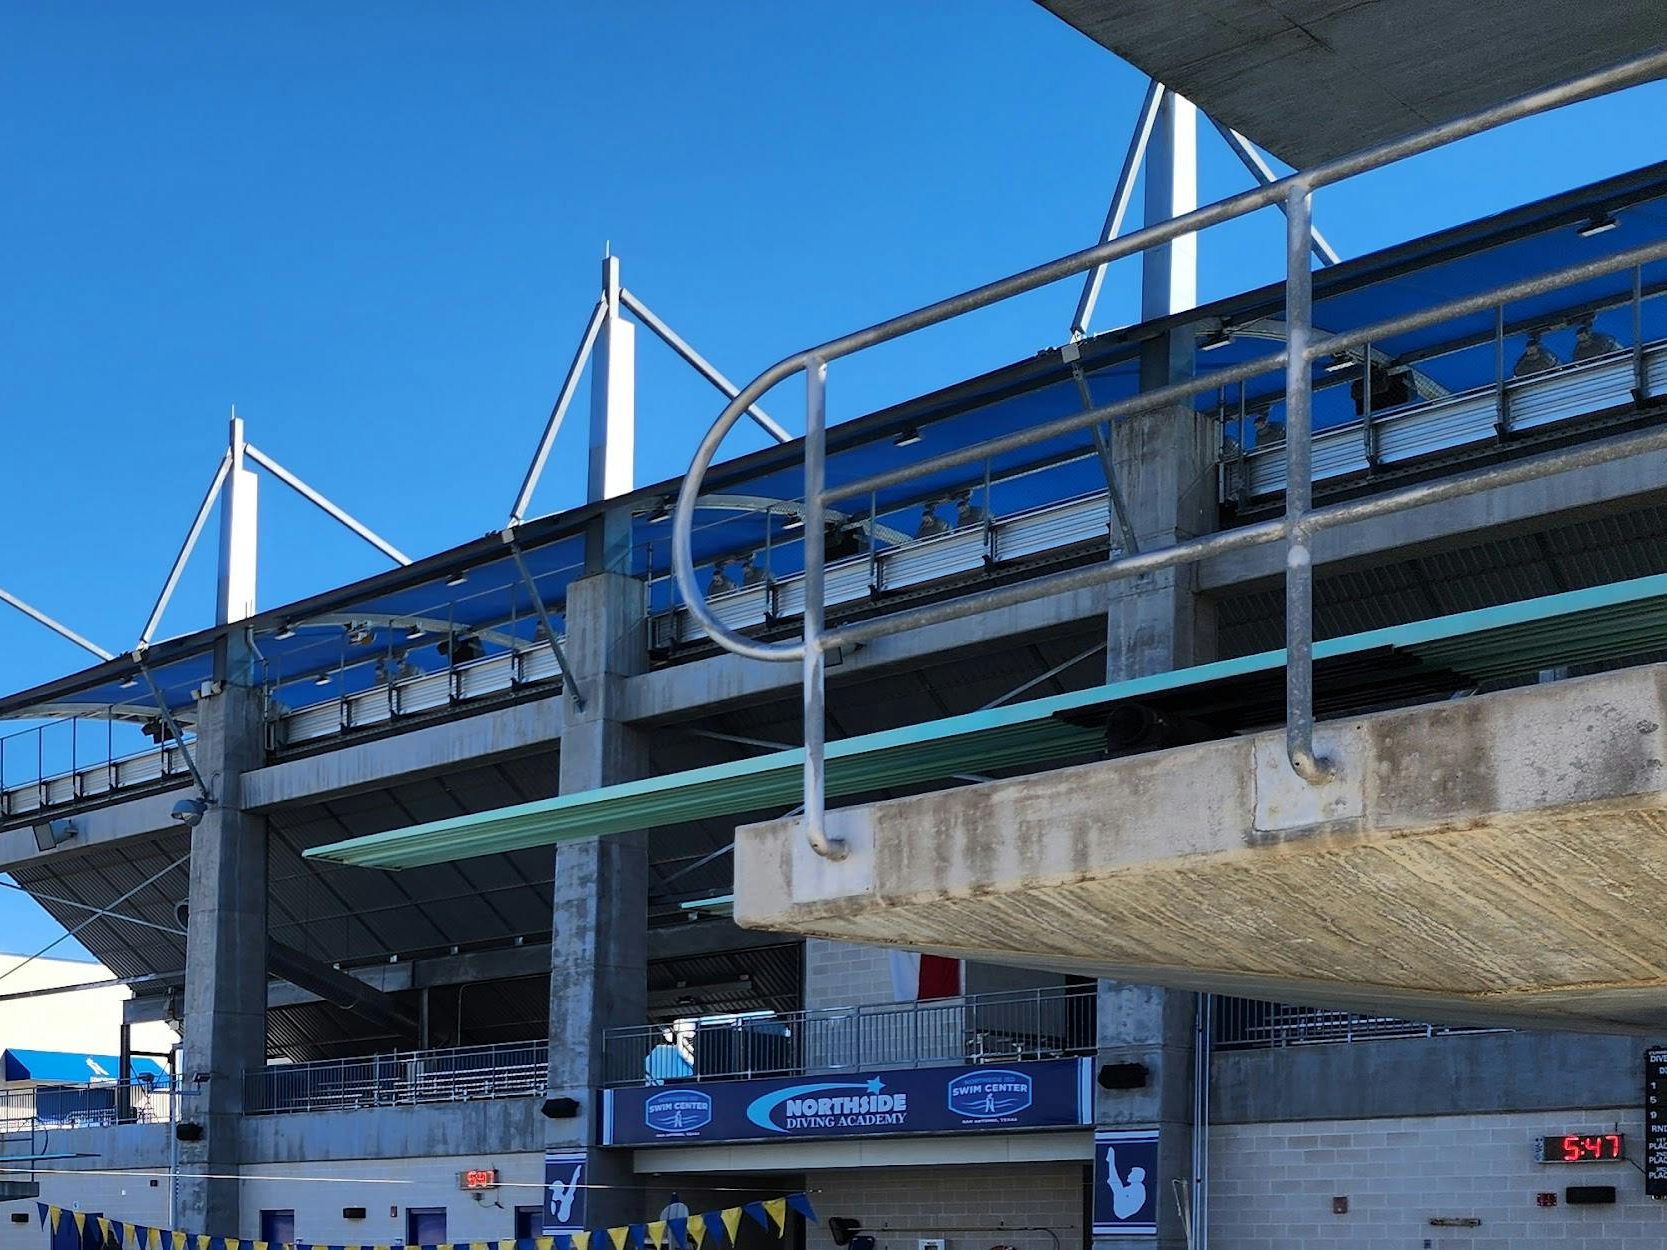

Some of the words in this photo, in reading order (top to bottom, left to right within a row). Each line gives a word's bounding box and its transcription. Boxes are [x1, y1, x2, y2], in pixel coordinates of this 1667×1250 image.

[952, 1084, 982, 1096] SWIM
[984, 1083, 1028, 1093] CENTER
[649, 1102, 673, 1113] SWIM
[674, 1101, 708, 1111] CENTER
[786, 1094, 907, 1117] NORTHSIDE
[1649, 1096, 1657, 1104] 5
[786, 1116, 835, 1129] DIVING
[837, 1113, 907, 1127] ACADEMY
[1563, 1135, 1620, 1162] 5:47
